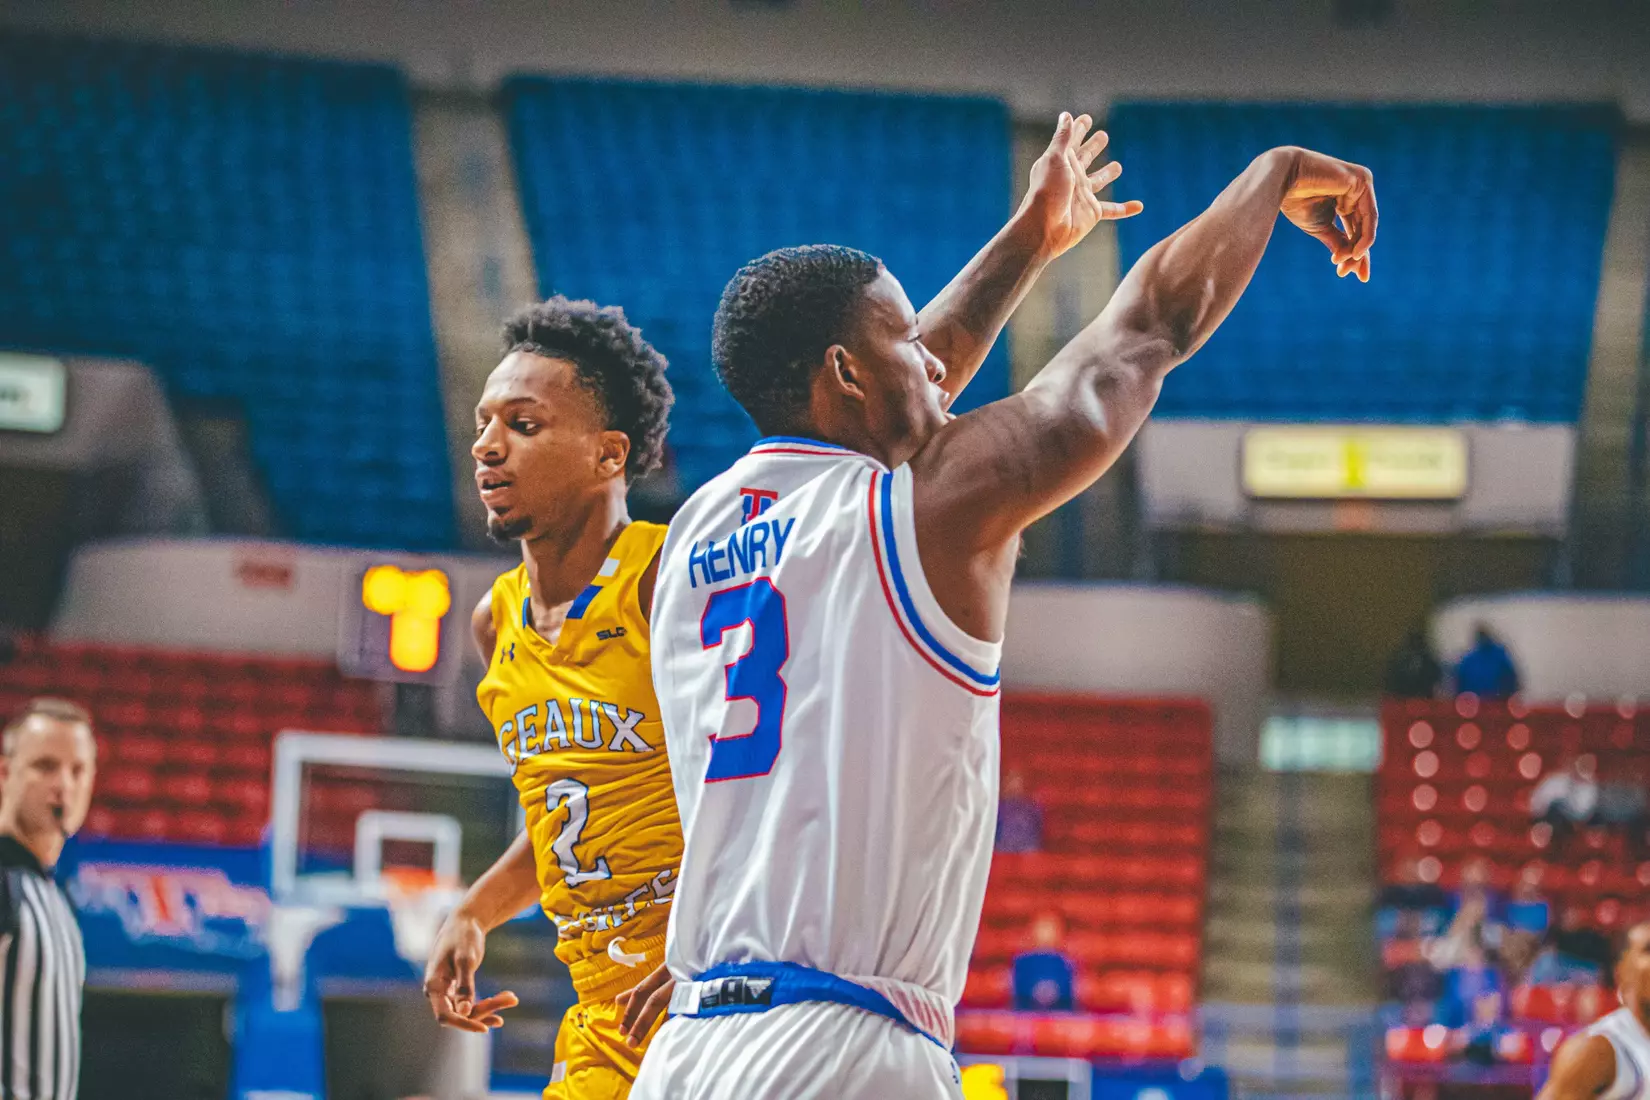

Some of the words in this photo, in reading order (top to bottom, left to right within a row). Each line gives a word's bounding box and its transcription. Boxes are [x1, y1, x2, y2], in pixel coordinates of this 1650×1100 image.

[688, 517, 796, 588] HENRY
[700, 576, 790, 784] 3
[498, 697, 656, 777] GEAUX
[544, 777, 612, 889] 2
